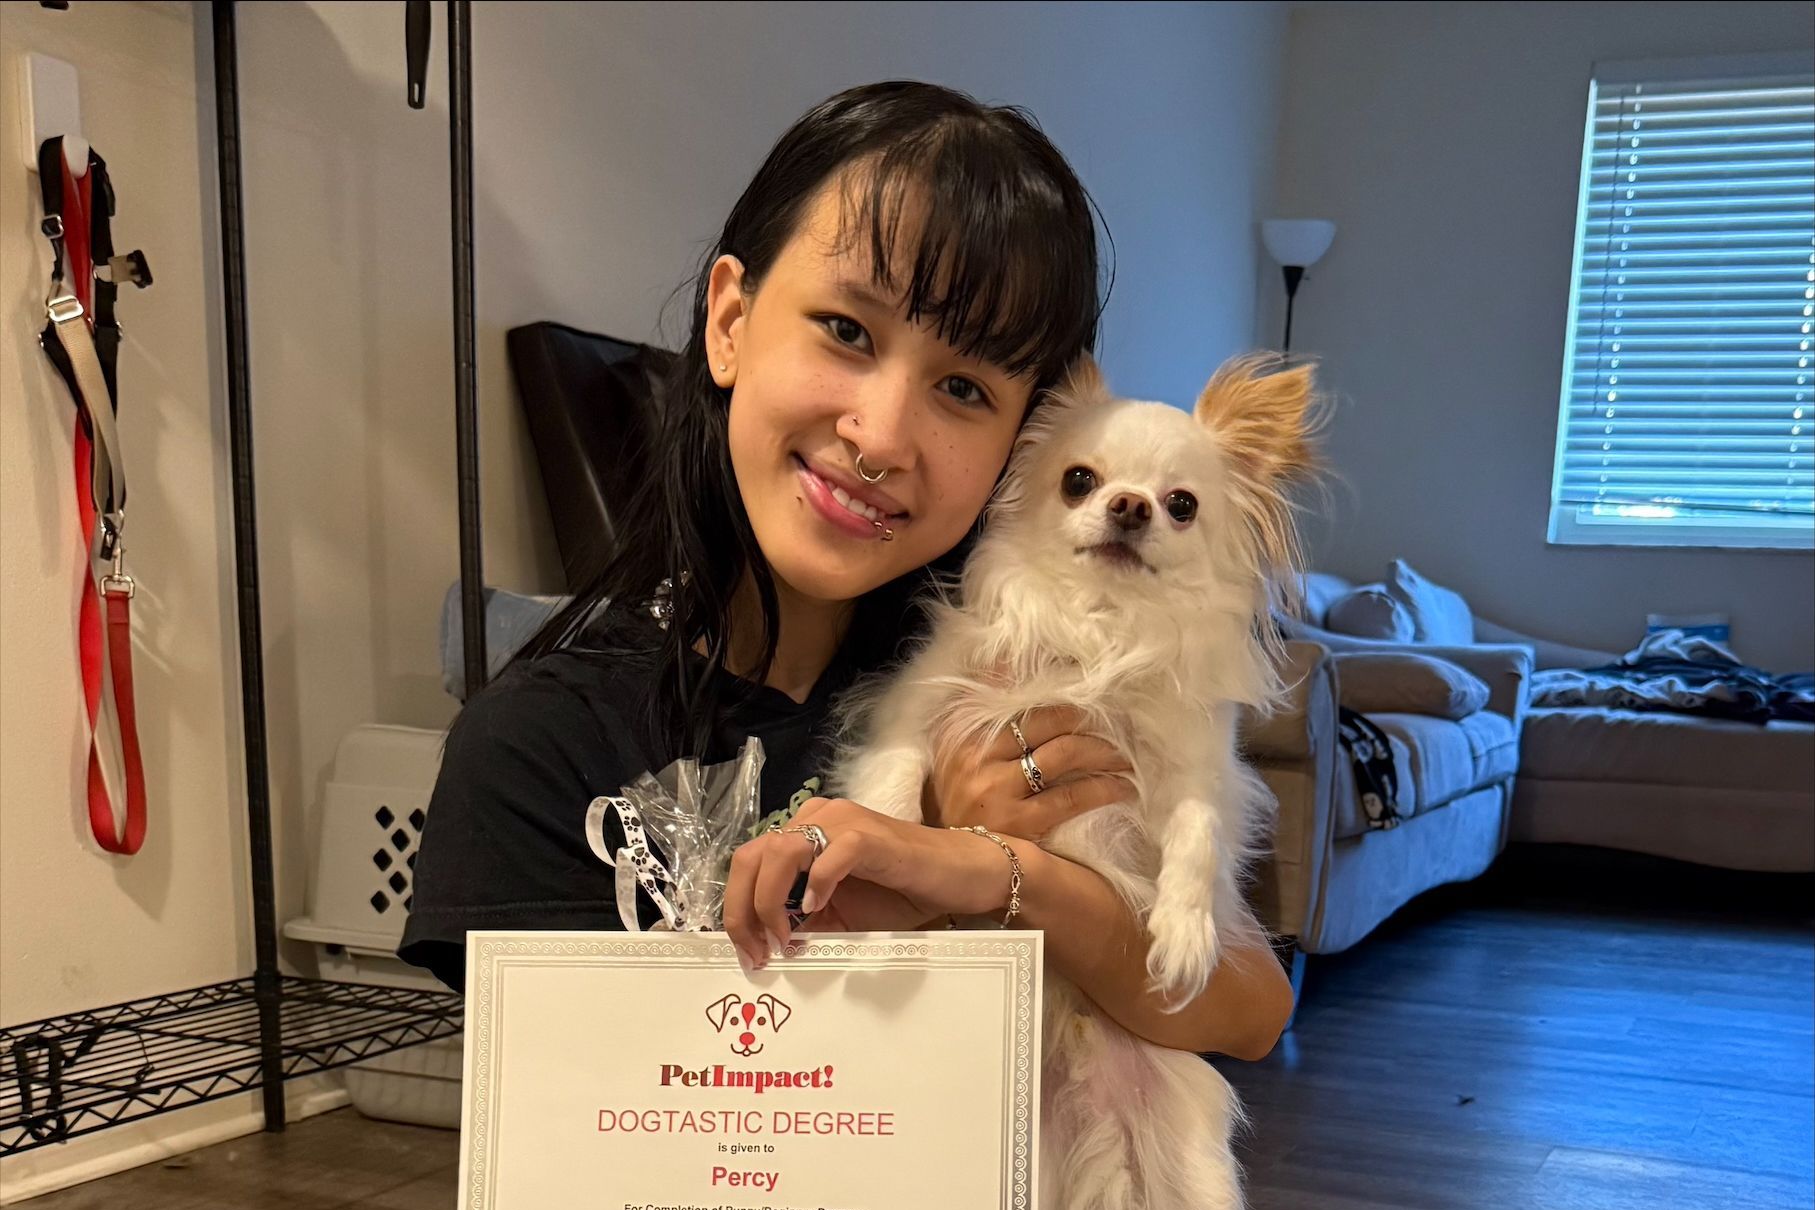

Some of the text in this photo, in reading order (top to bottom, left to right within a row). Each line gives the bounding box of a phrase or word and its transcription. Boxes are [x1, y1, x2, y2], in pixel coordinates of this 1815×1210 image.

[658, 1064, 834, 1094] PetImpact!
[598, 1109, 895, 1136] DOGTASTIC DEGREE
[718, 1142, 775, 1155] is given to
[711, 1166, 780, 1192] Percy
